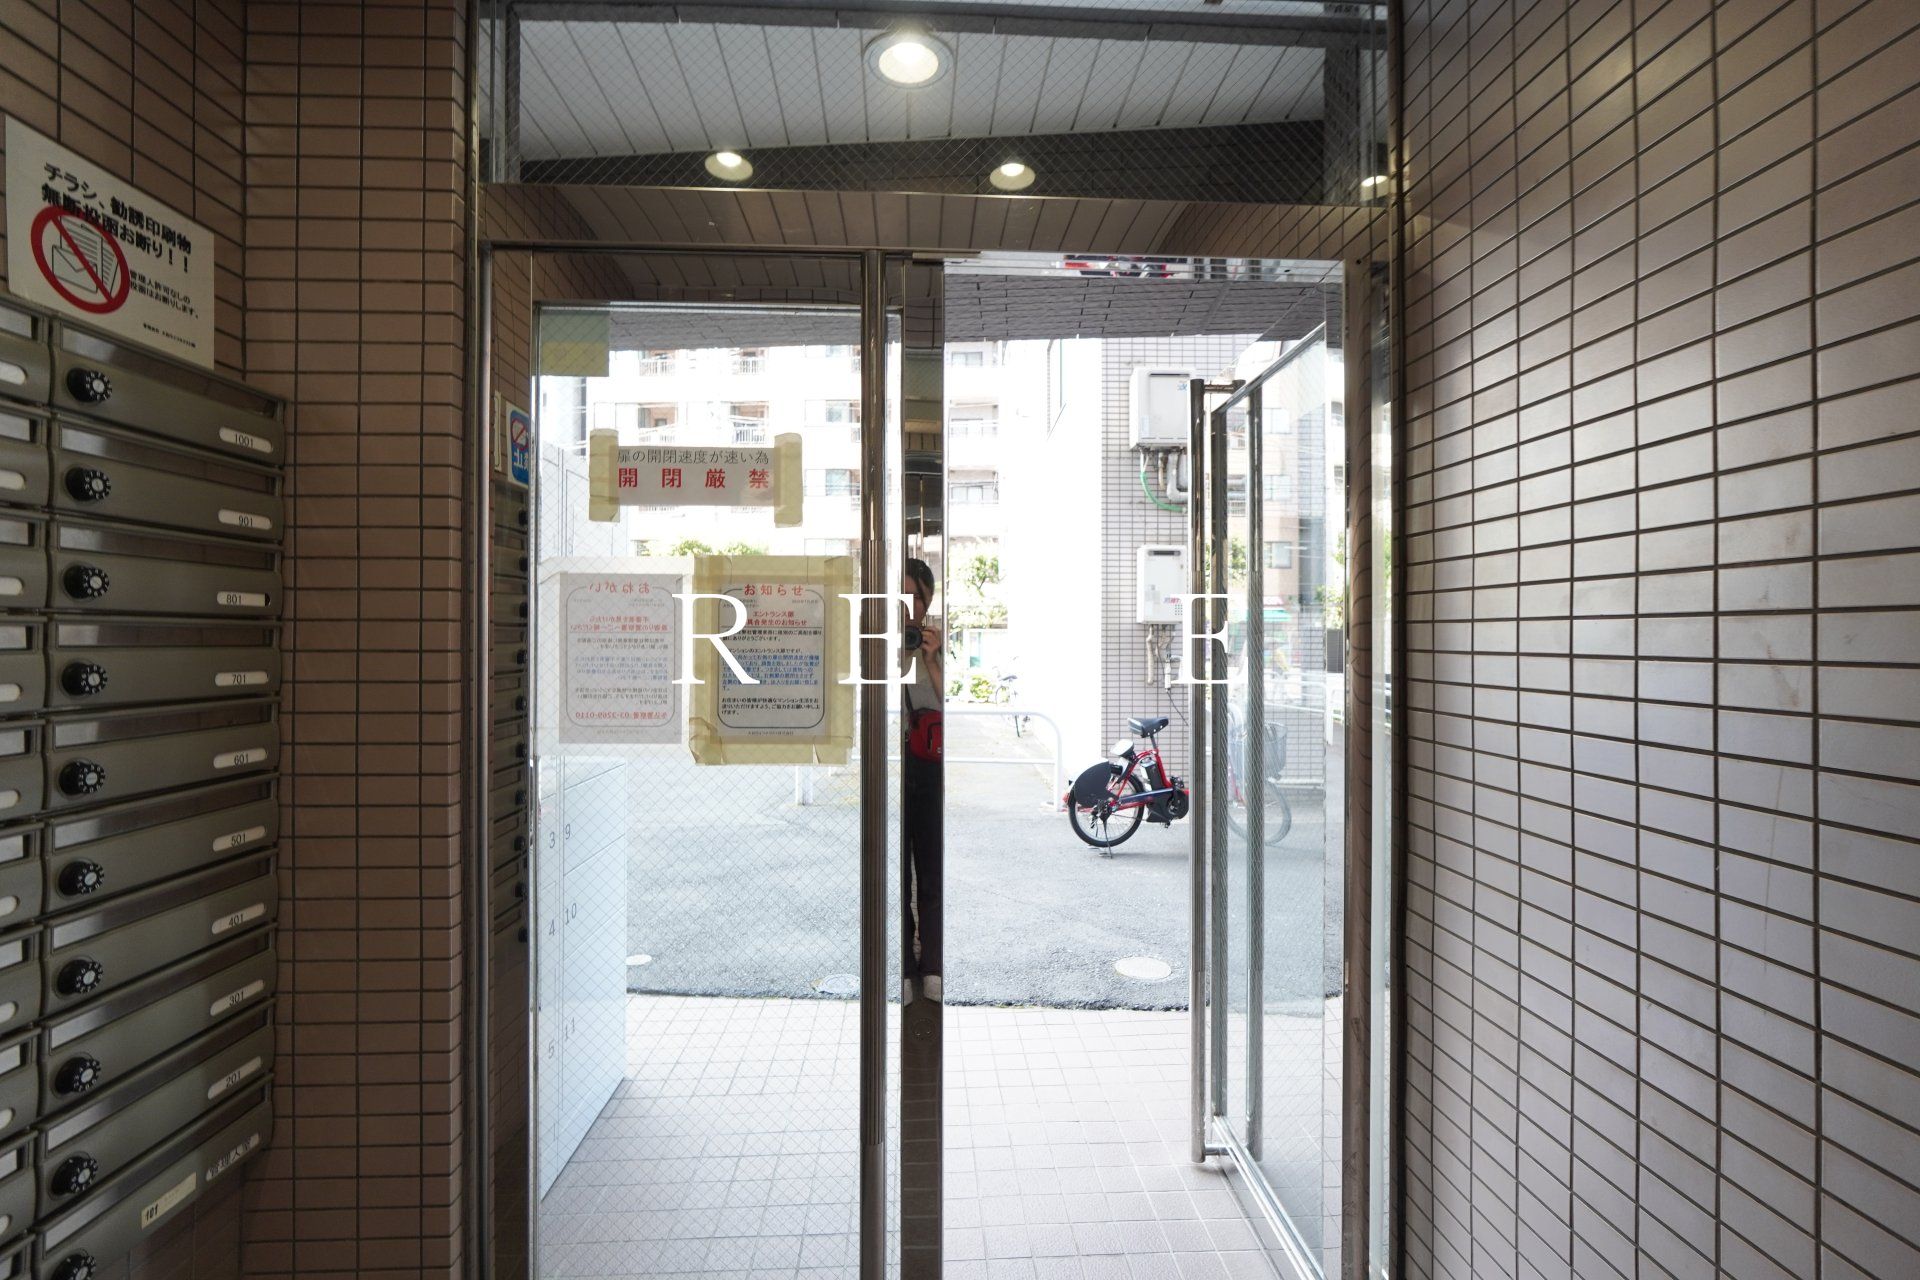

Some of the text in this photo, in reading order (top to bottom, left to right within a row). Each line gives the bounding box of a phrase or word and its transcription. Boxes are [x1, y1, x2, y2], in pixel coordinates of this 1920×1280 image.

[44, 162, 191, 254] チラシ、勧誘印刷物
[234, 433, 254, 447] 1001
[617, 450, 769, 465] 扉の開閉速度が速い為
[618, 468, 769, 488] 開閉厳禁
[238, 515, 254, 528] 901
[744, 584, 803, 596] お知らせ
[226, 594, 243, 605] 801
[232, 673, 247, 684] 701
[233, 753, 250, 766] 601
[565, 823, 571, 840] 9
[231, 833, 247, 846] 501
[549, 831, 556, 849] 3
[228, 914, 245, 928] 401
[565, 903, 577, 926] 10
[549, 919, 556, 936] 4
[229, 991, 245, 1007] 301
[226, 1071, 242, 1088] 201
[144, 1203, 159, 1222] 101
